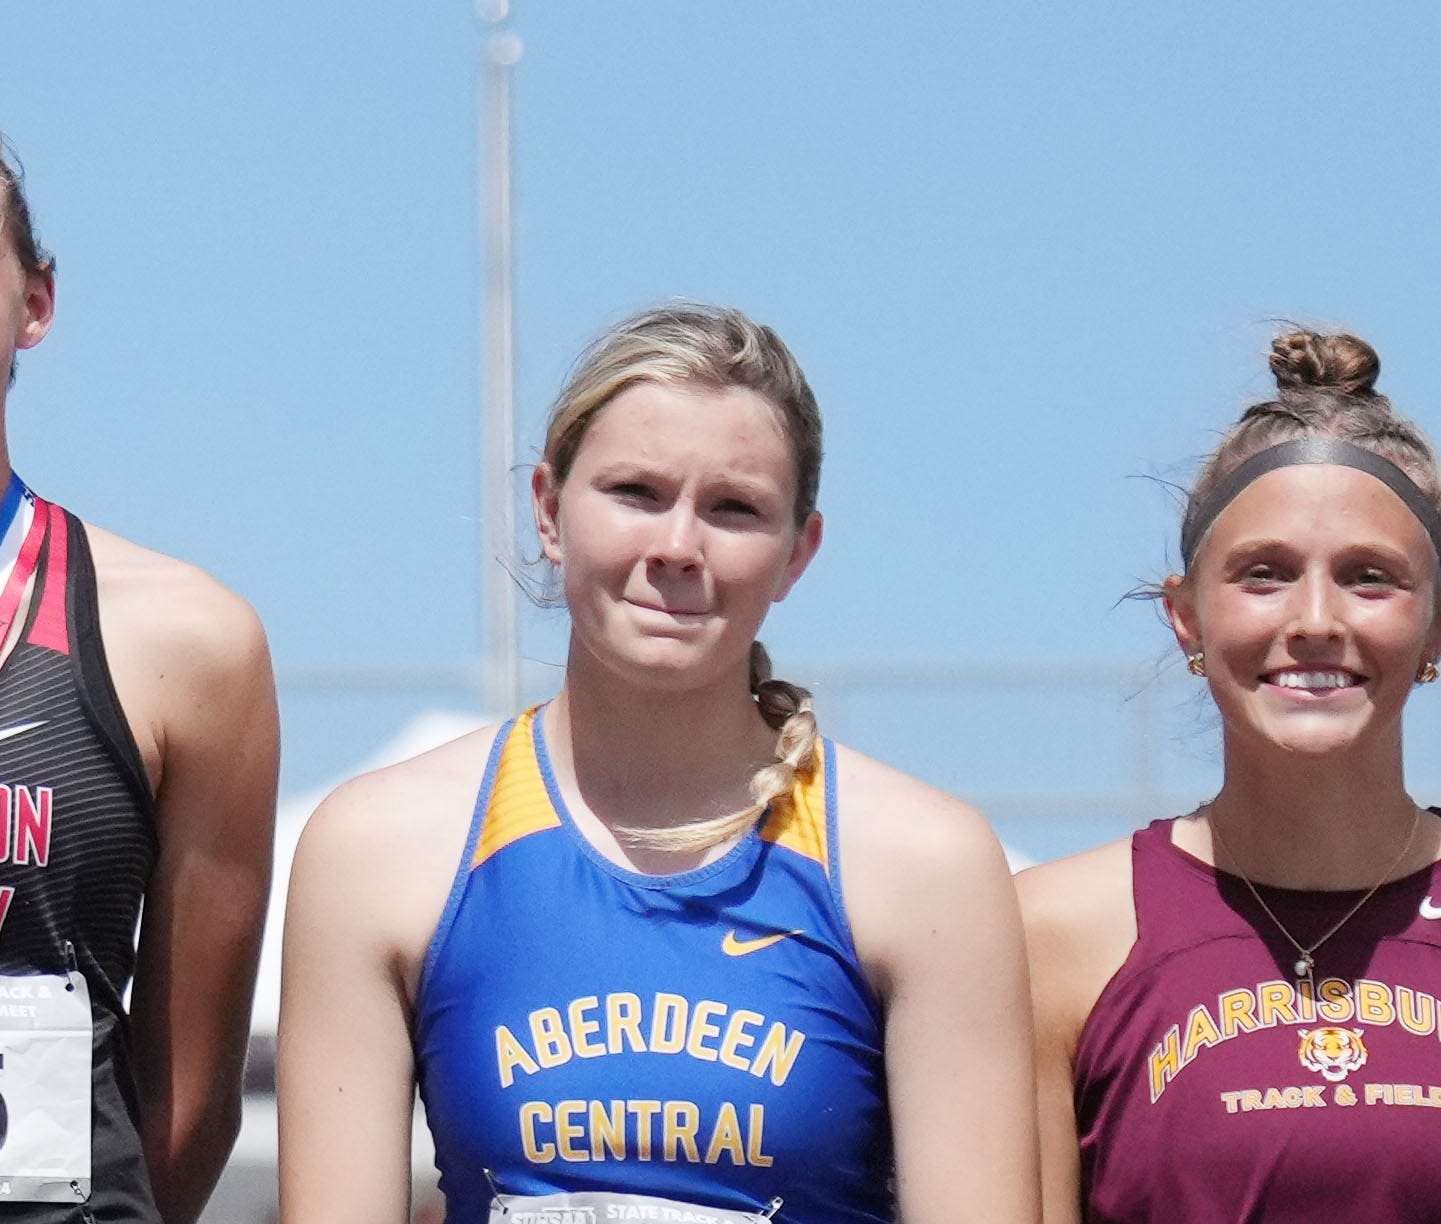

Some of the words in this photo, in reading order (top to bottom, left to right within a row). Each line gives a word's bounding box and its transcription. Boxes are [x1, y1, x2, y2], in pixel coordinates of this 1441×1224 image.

[40, 985, 52, 998] &
[494, 992, 805, 1088] ABERDEEN
[1220, 1085, 1326, 1113] TRACK
[1334, 1084, 1358, 1107] &
[518, 1100, 774, 1167] CENTRAL
[607, 1204, 660, 1220] STATE
